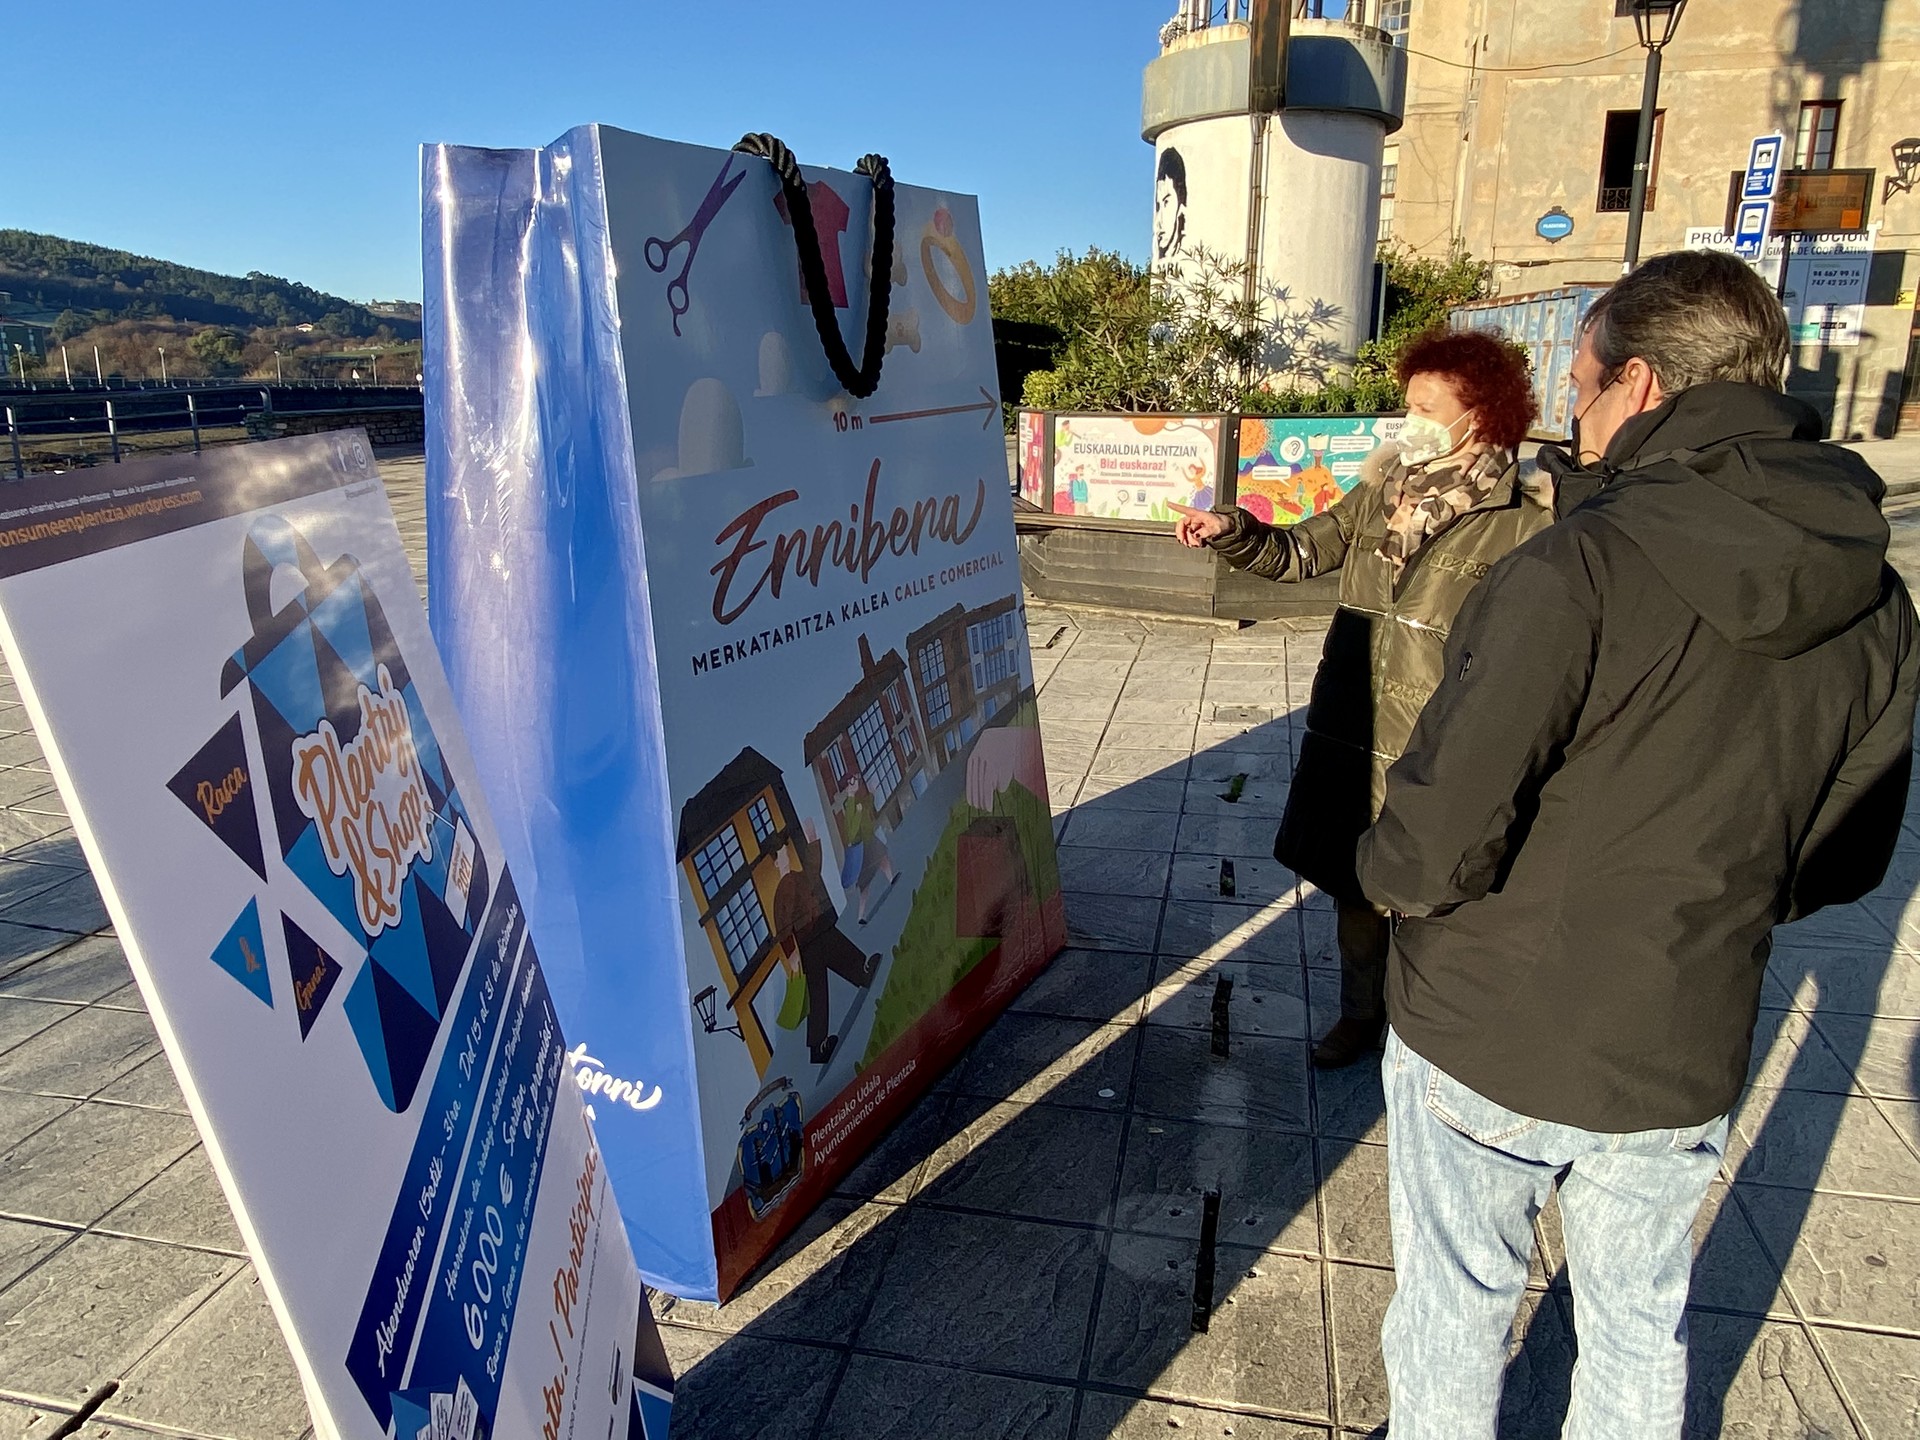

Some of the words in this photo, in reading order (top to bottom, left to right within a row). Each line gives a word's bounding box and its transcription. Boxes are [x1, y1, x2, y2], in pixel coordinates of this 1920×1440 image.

[1691, 230, 1734, 244] PRÓX
[1811, 246, 1868, 255] COOPERATIVA
[833, 411, 848, 432] 10
[851, 415, 863, 430] m
[1074, 443, 1141, 456] EUSKARALDIA
[1143, 445, 1198, 458] PLENTZIAN
[1100, 458, 1117, 469] Bizi
[1120, 459, 1167, 471] euskaraz!
[0, 490, 203, 548] onsumeenplentzia.wordpress.com
[691, 611, 836, 676] MERKATARITZA
[841, 592, 890, 622] KALEA
[894, 574, 936, 602] CALLE
[939, 552, 1004, 586] COMERCIAL
[196, 766, 248, 825] Rasca
[366, 745, 432, 896] Shop!
[484, 974, 494, 1001] 31
[490, 959, 502, 983] de
[479, 991, 490, 1024] al
[470, 1016, 483, 1045] 15
[459, 1034, 478, 1081] Del
[523, 1107, 535, 1140] en
[811, 1099, 856, 1148] Plentziako
[857, 1074, 882, 1106] Udala
[814, 1100, 875, 1167] Ayuntamiento
[875, 1090, 886, 1107] de
[886, 1060, 917, 1095] Plentzia
[464, 1205, 504, 1350] 6.000
[500, 1162, 514, 1209] €
[374, 1225, 426, 1378] Abenduaren
